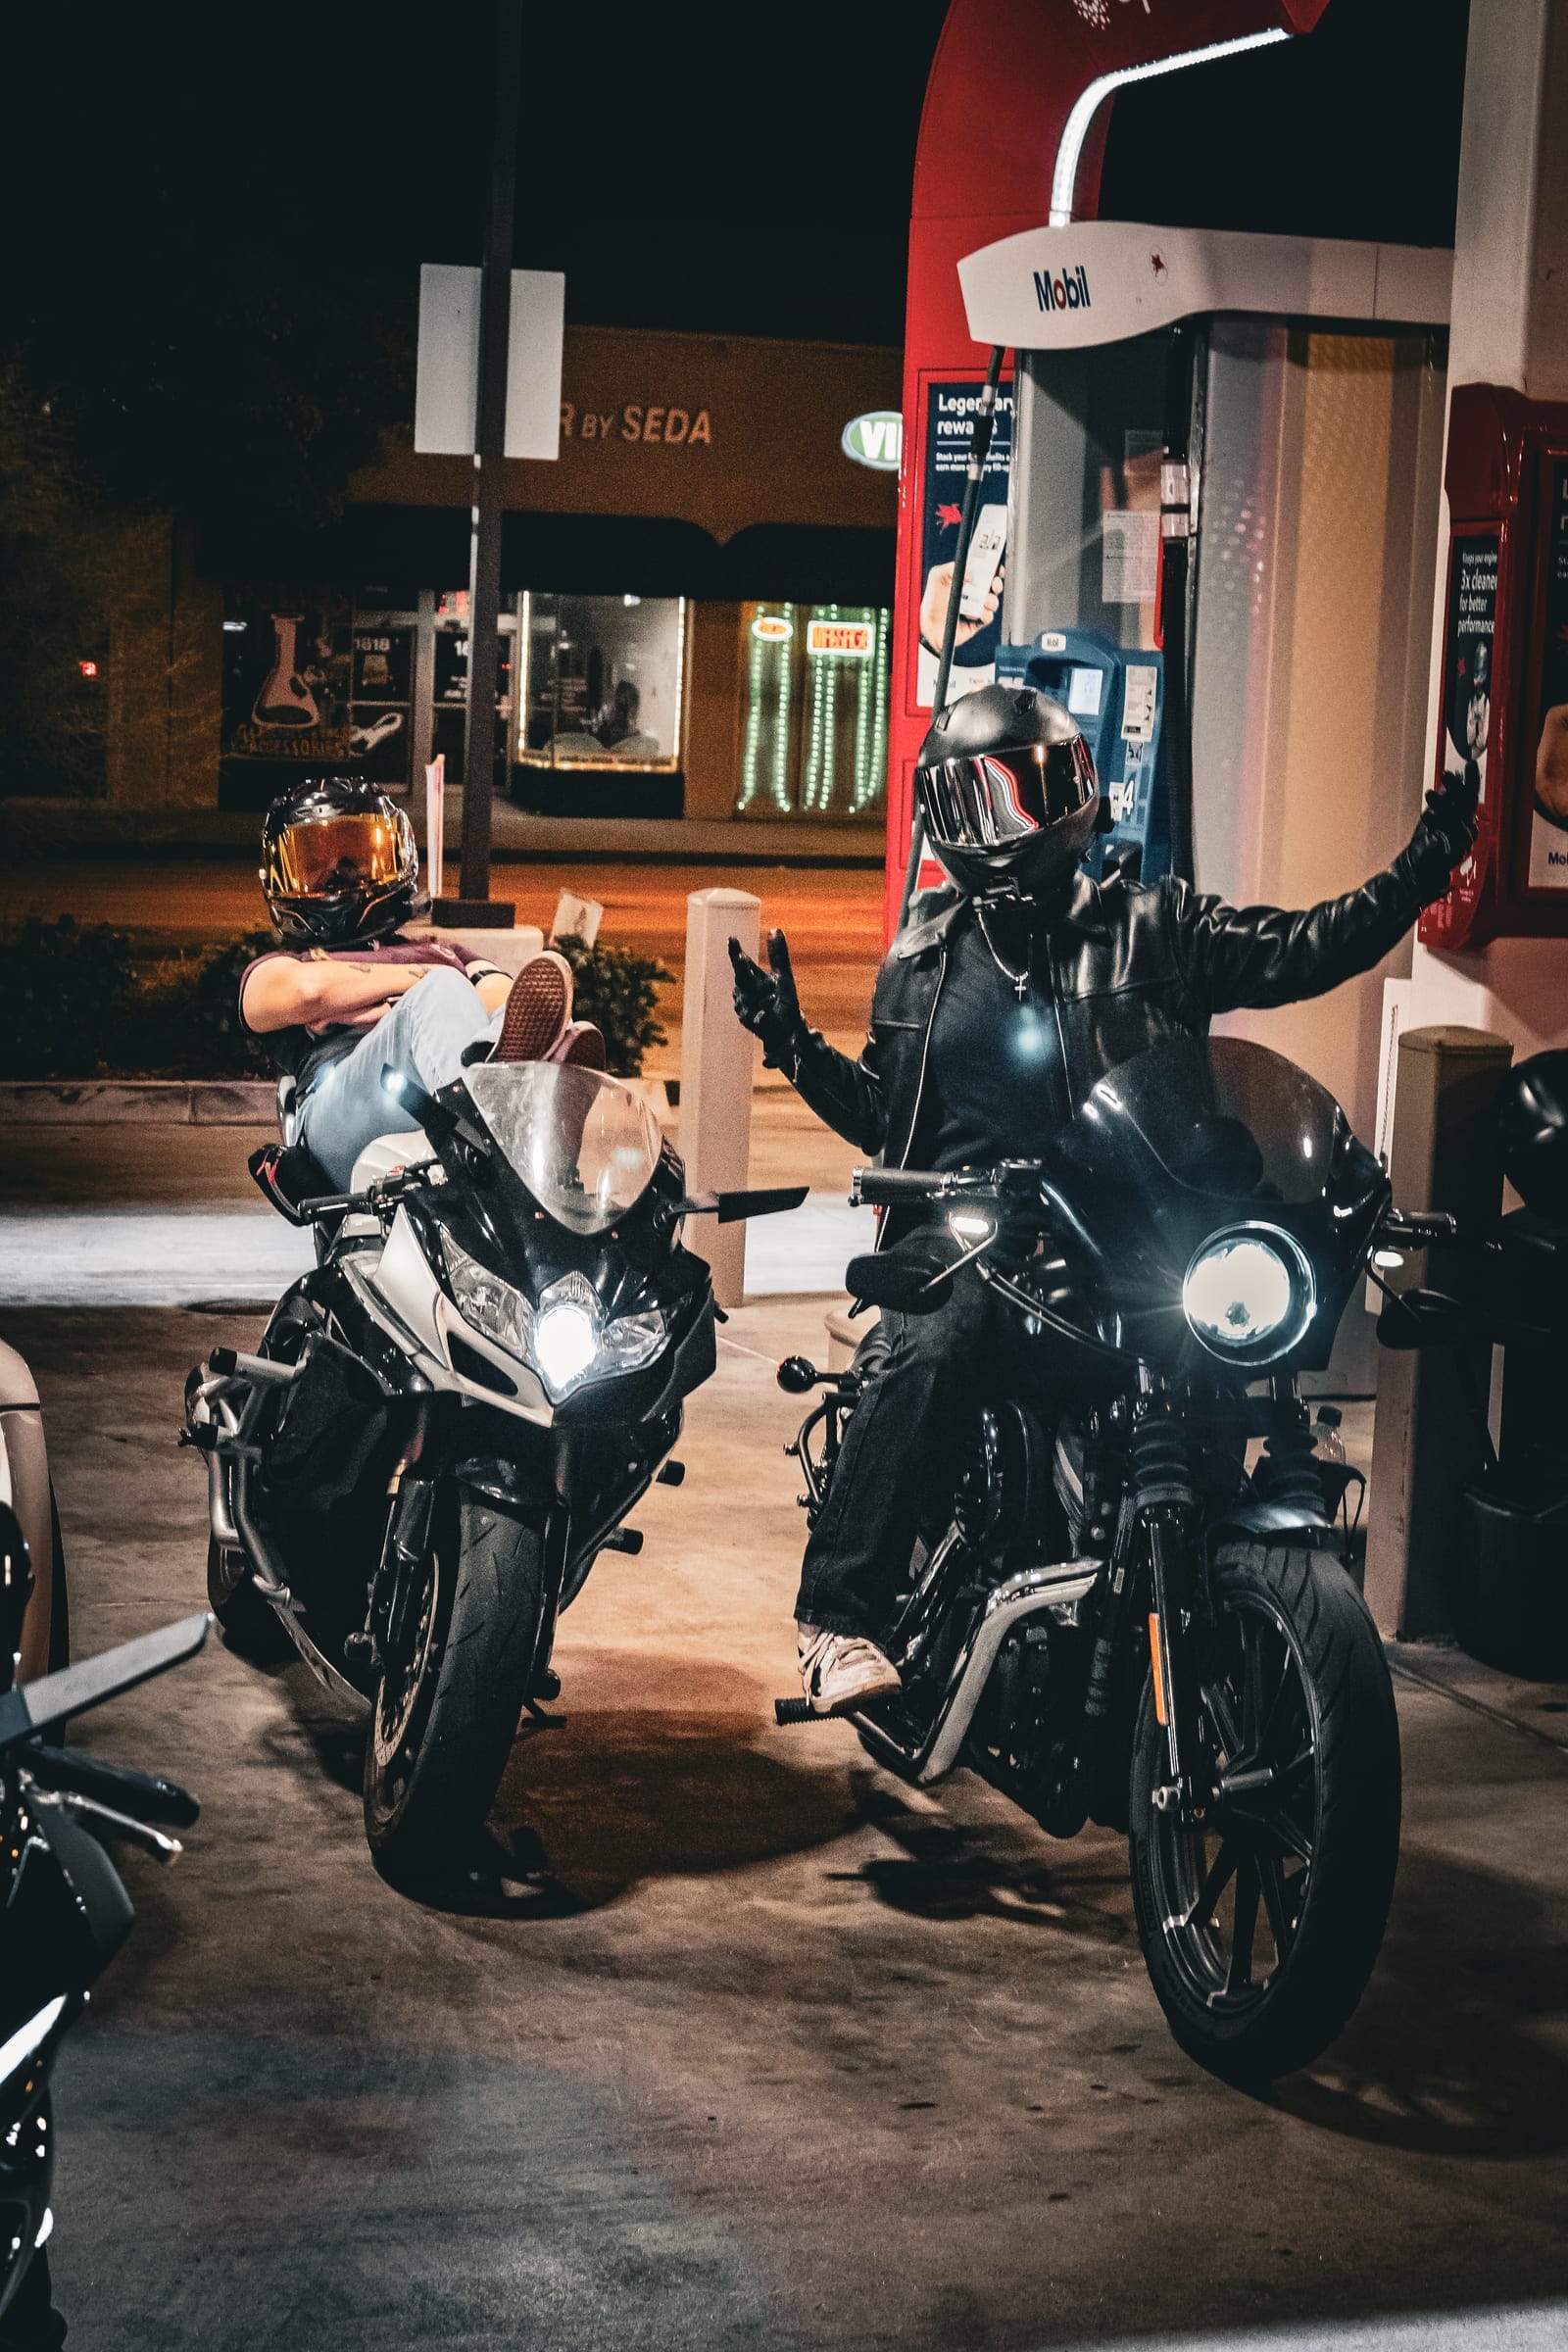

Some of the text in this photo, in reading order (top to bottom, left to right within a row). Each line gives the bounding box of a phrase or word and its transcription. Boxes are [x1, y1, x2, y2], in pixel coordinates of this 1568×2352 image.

[1033, 266, 1091, 312] Mobil
[580, 414, 613, 439] BY
[621, 405, 711, 444] SEDA
[937, 420, 998, 435] rewas
[1461, 567, 1471, 591] 3x
[1459, 592, 1488, 612] for better
[1457, 613, 1495, 639] performance
